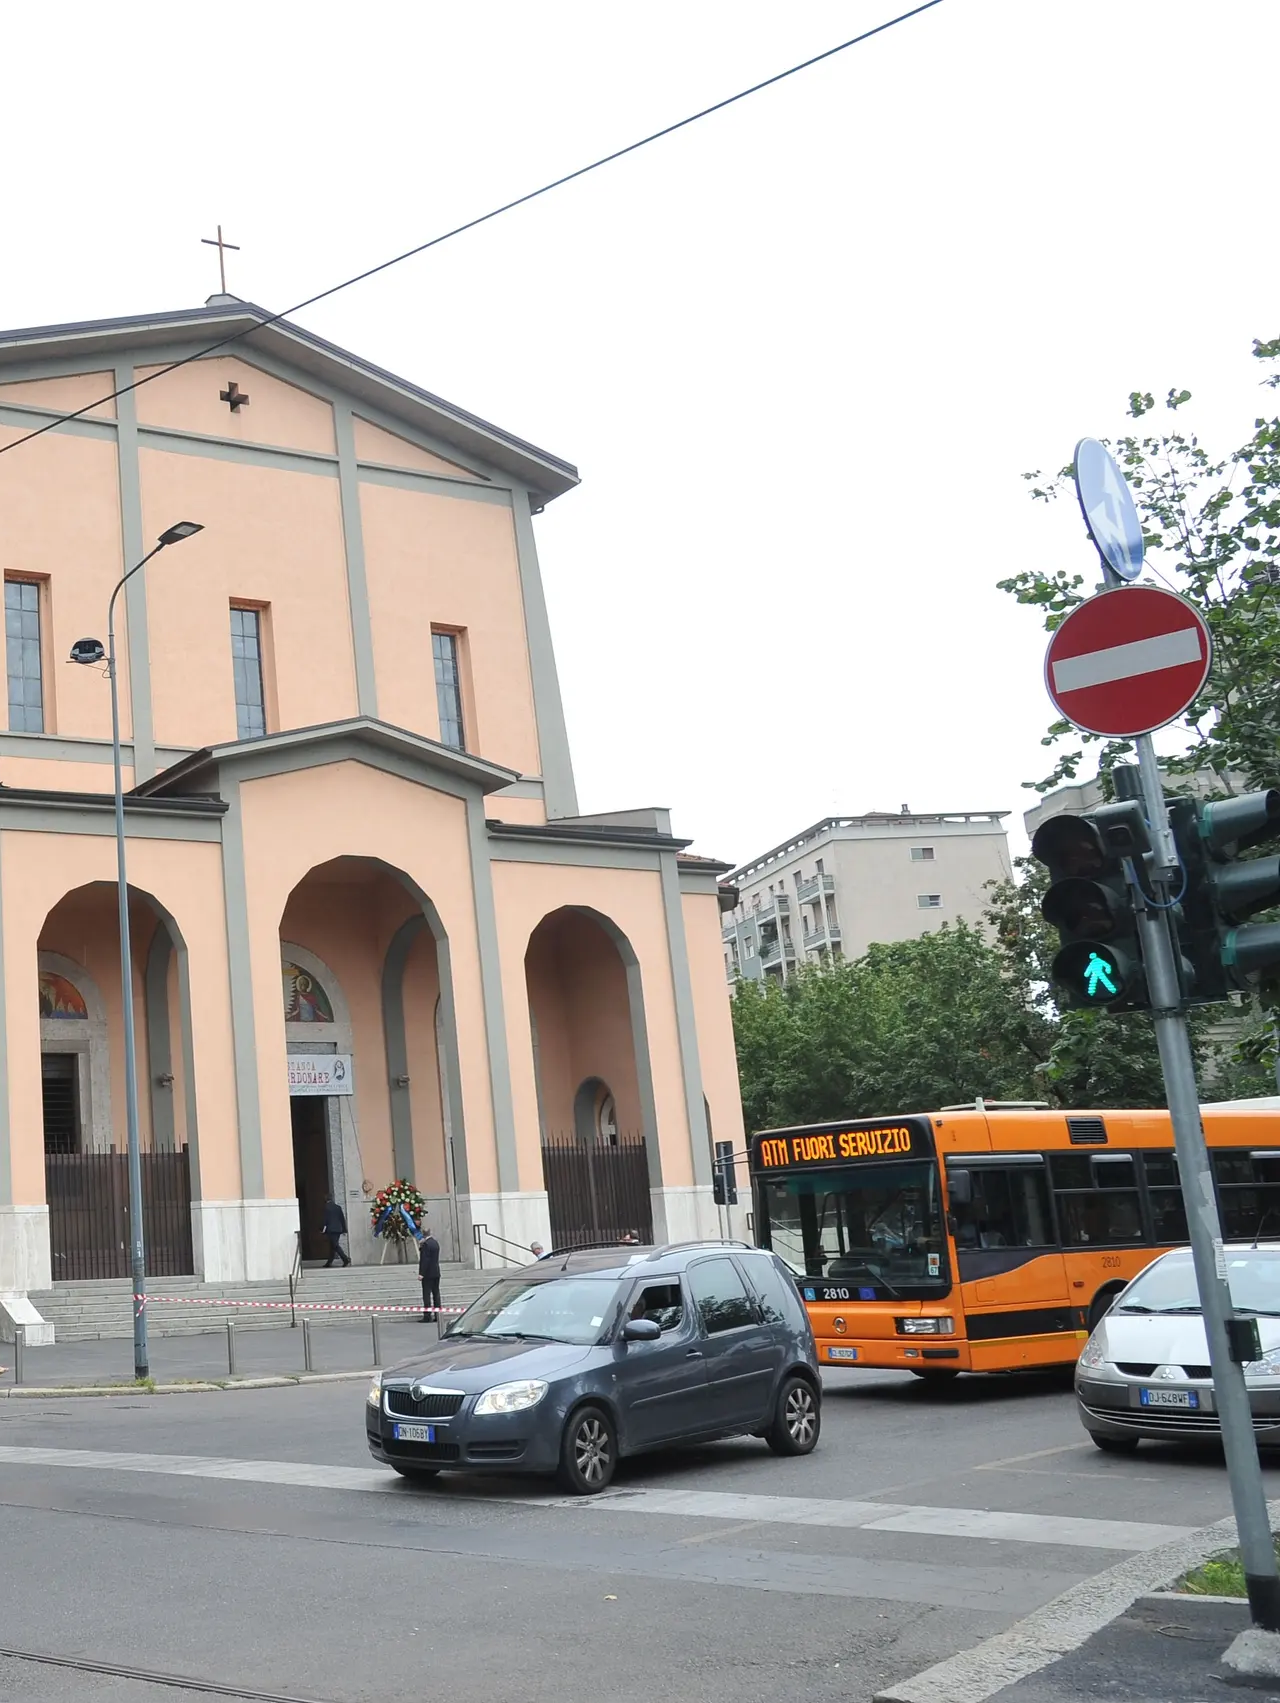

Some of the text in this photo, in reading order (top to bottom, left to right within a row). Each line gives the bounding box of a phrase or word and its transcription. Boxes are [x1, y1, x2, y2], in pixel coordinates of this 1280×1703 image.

[288, 1072, 330, 1084] RDONARE
[761, 1127, 911, 1167] ATM FUORI SERVIZIO
[823, 1287, 850, 1300] 2810
